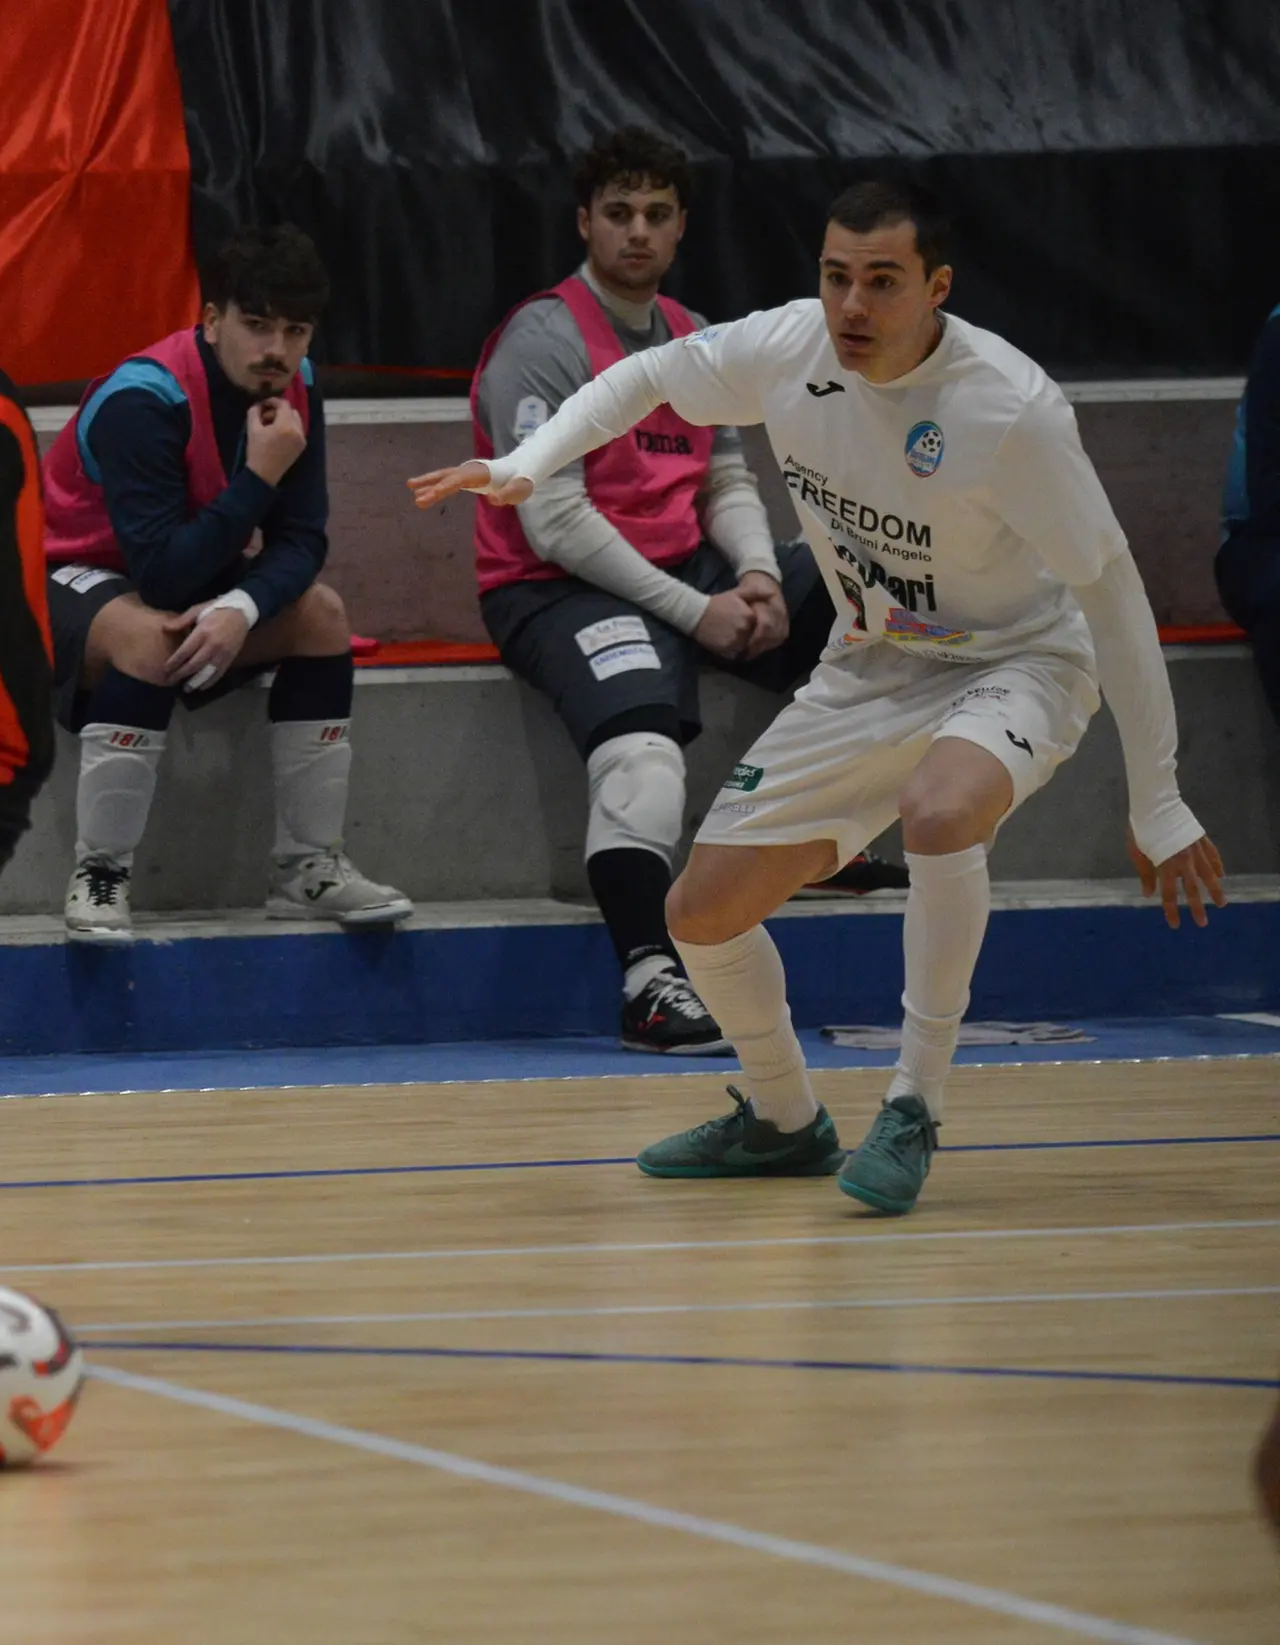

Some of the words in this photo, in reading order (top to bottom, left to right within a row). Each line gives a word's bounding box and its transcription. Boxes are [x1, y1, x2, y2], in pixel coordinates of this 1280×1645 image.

[784, 454, 828, 487] Agency
[783, 470, 932, 548] FREEDOM
[847, 526, 878, 550] Bruni
[880, 541, 932, 562] Angelo
